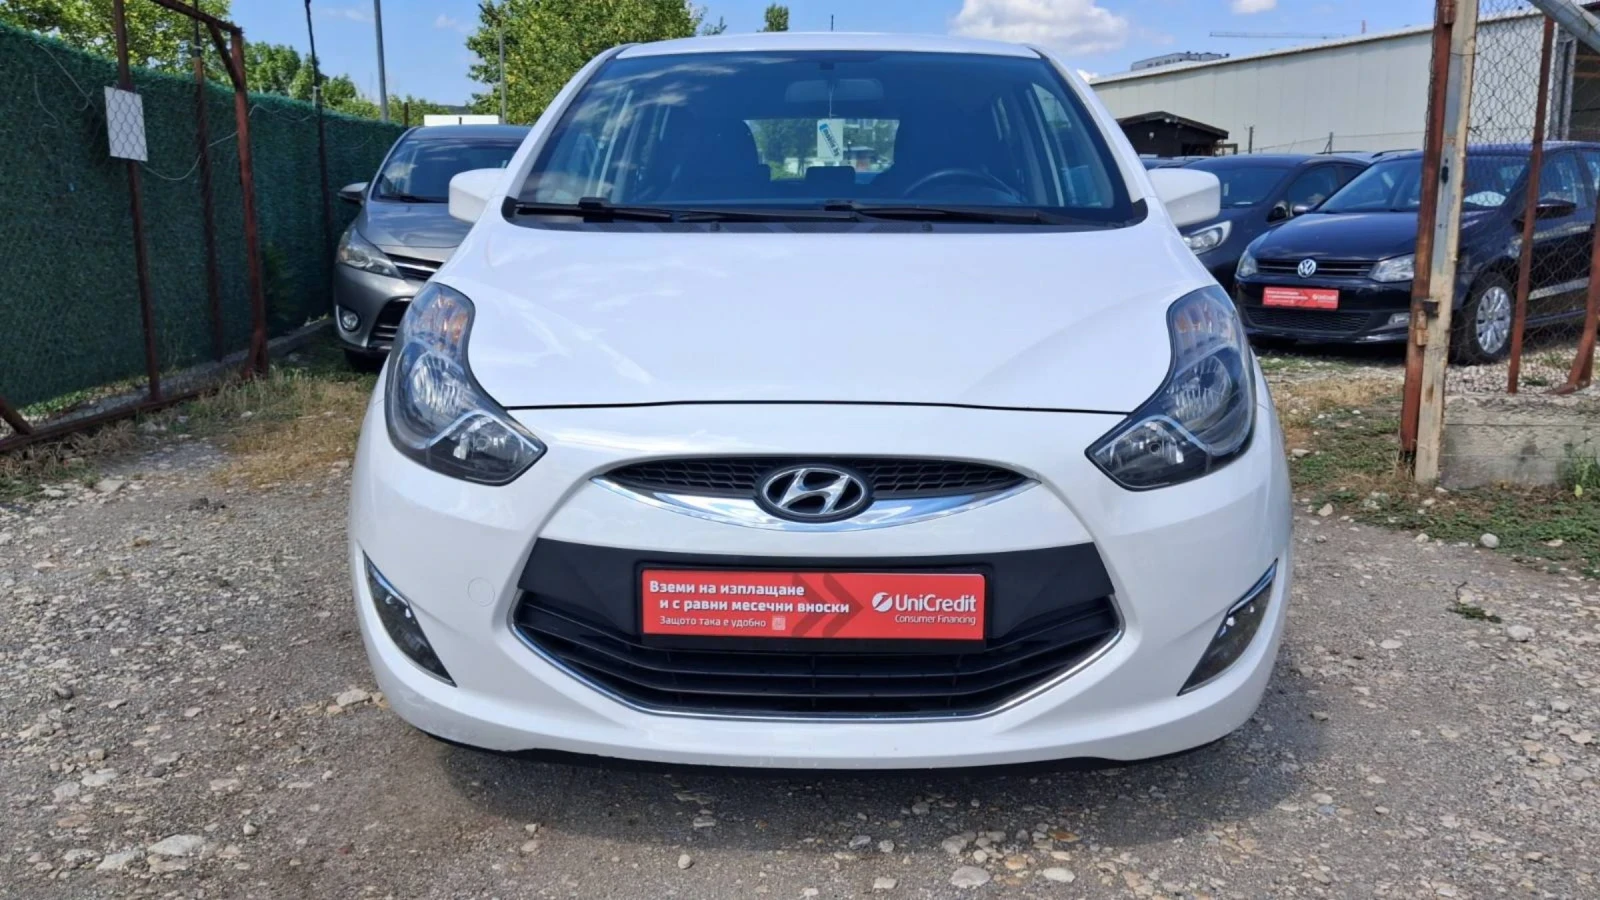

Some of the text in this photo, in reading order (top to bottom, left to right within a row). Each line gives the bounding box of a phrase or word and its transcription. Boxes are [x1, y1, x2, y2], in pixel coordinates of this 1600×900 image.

[649, 580, 805, 597] Вземи на изплащане
[659, 600, 850, 613] и с равни месечни вноски
[895, 594, 977, 612] UniCredit
[659, 616, 697, 627] Защото
[699, 618, 721, 627] така
[731, 618, 766, 628] удобно
[895, 614, 976, 626] Consumer Financing
